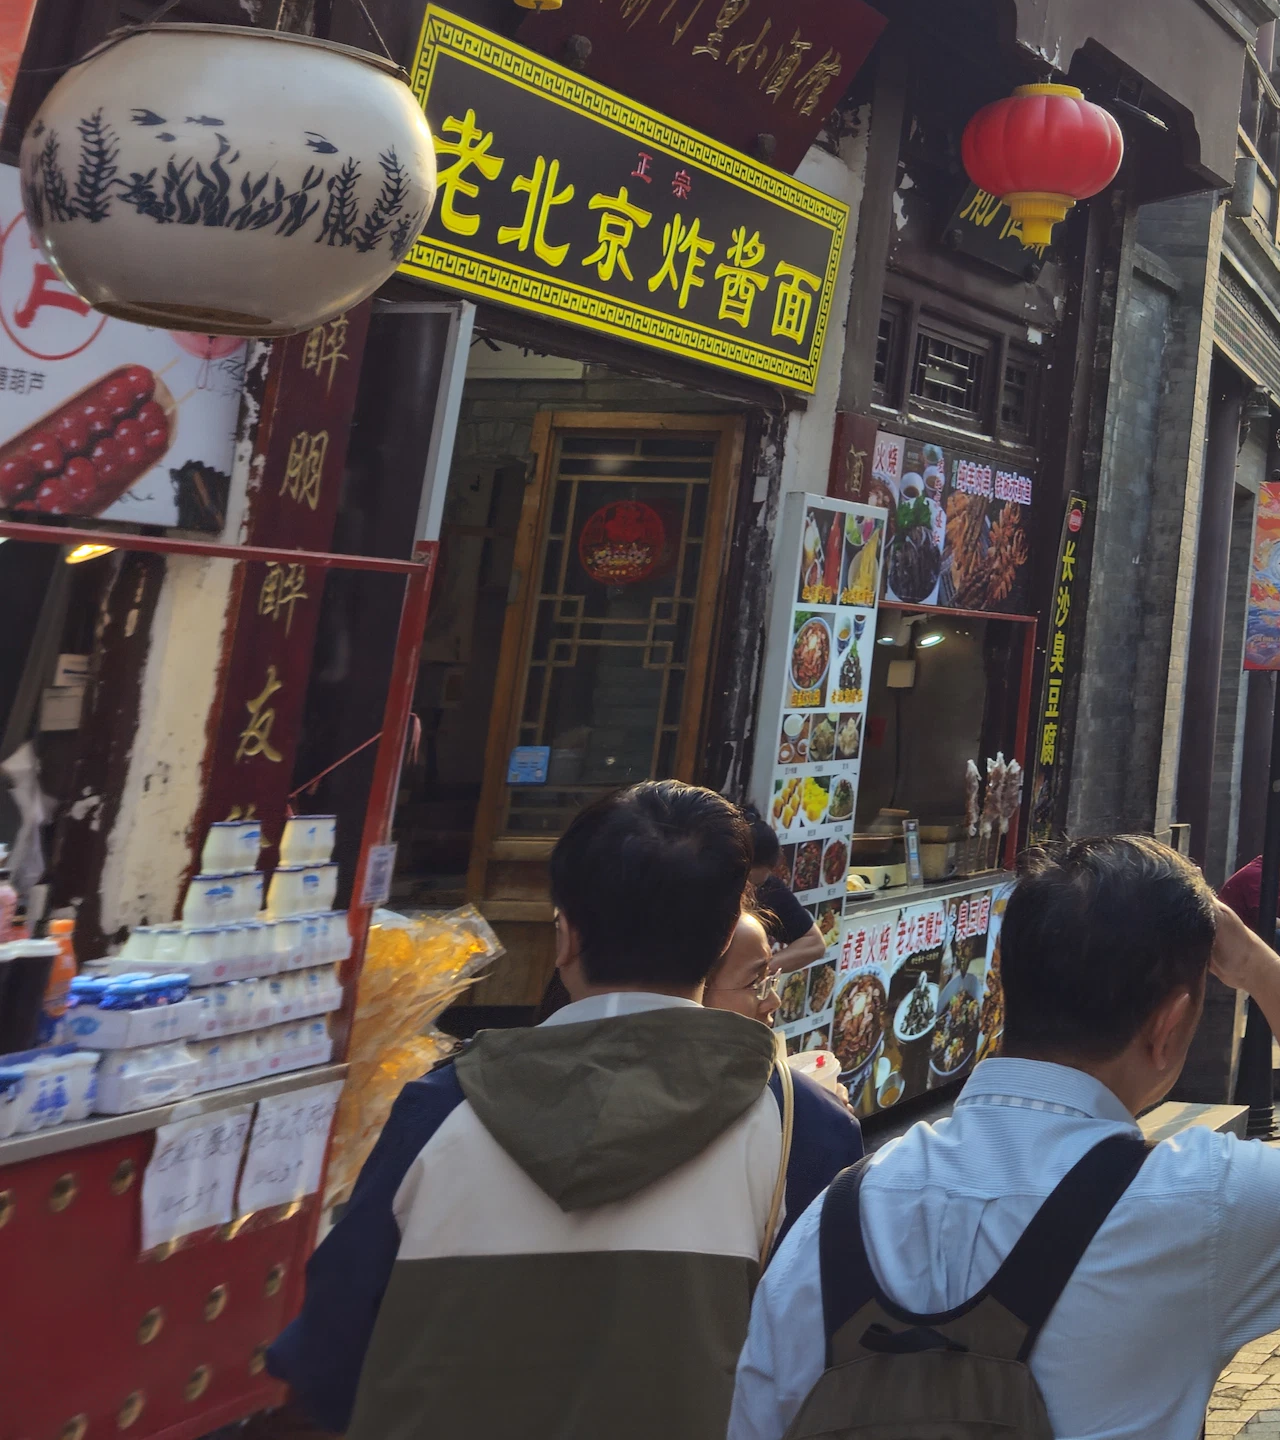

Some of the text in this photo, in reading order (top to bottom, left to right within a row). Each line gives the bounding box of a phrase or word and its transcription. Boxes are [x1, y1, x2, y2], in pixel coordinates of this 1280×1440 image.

[434, 108, 823, 346] 老北京炸酱面
[631, 151, 692, 200] 正宗
[233, 310, 350, 850] 醉朋醉友
[1040, 540, 1076, 767] 长沙臭豆腐
[840, 922, 893, 972] 卤煮火烧
[955, 896, 990, 941] 臭豆腐
